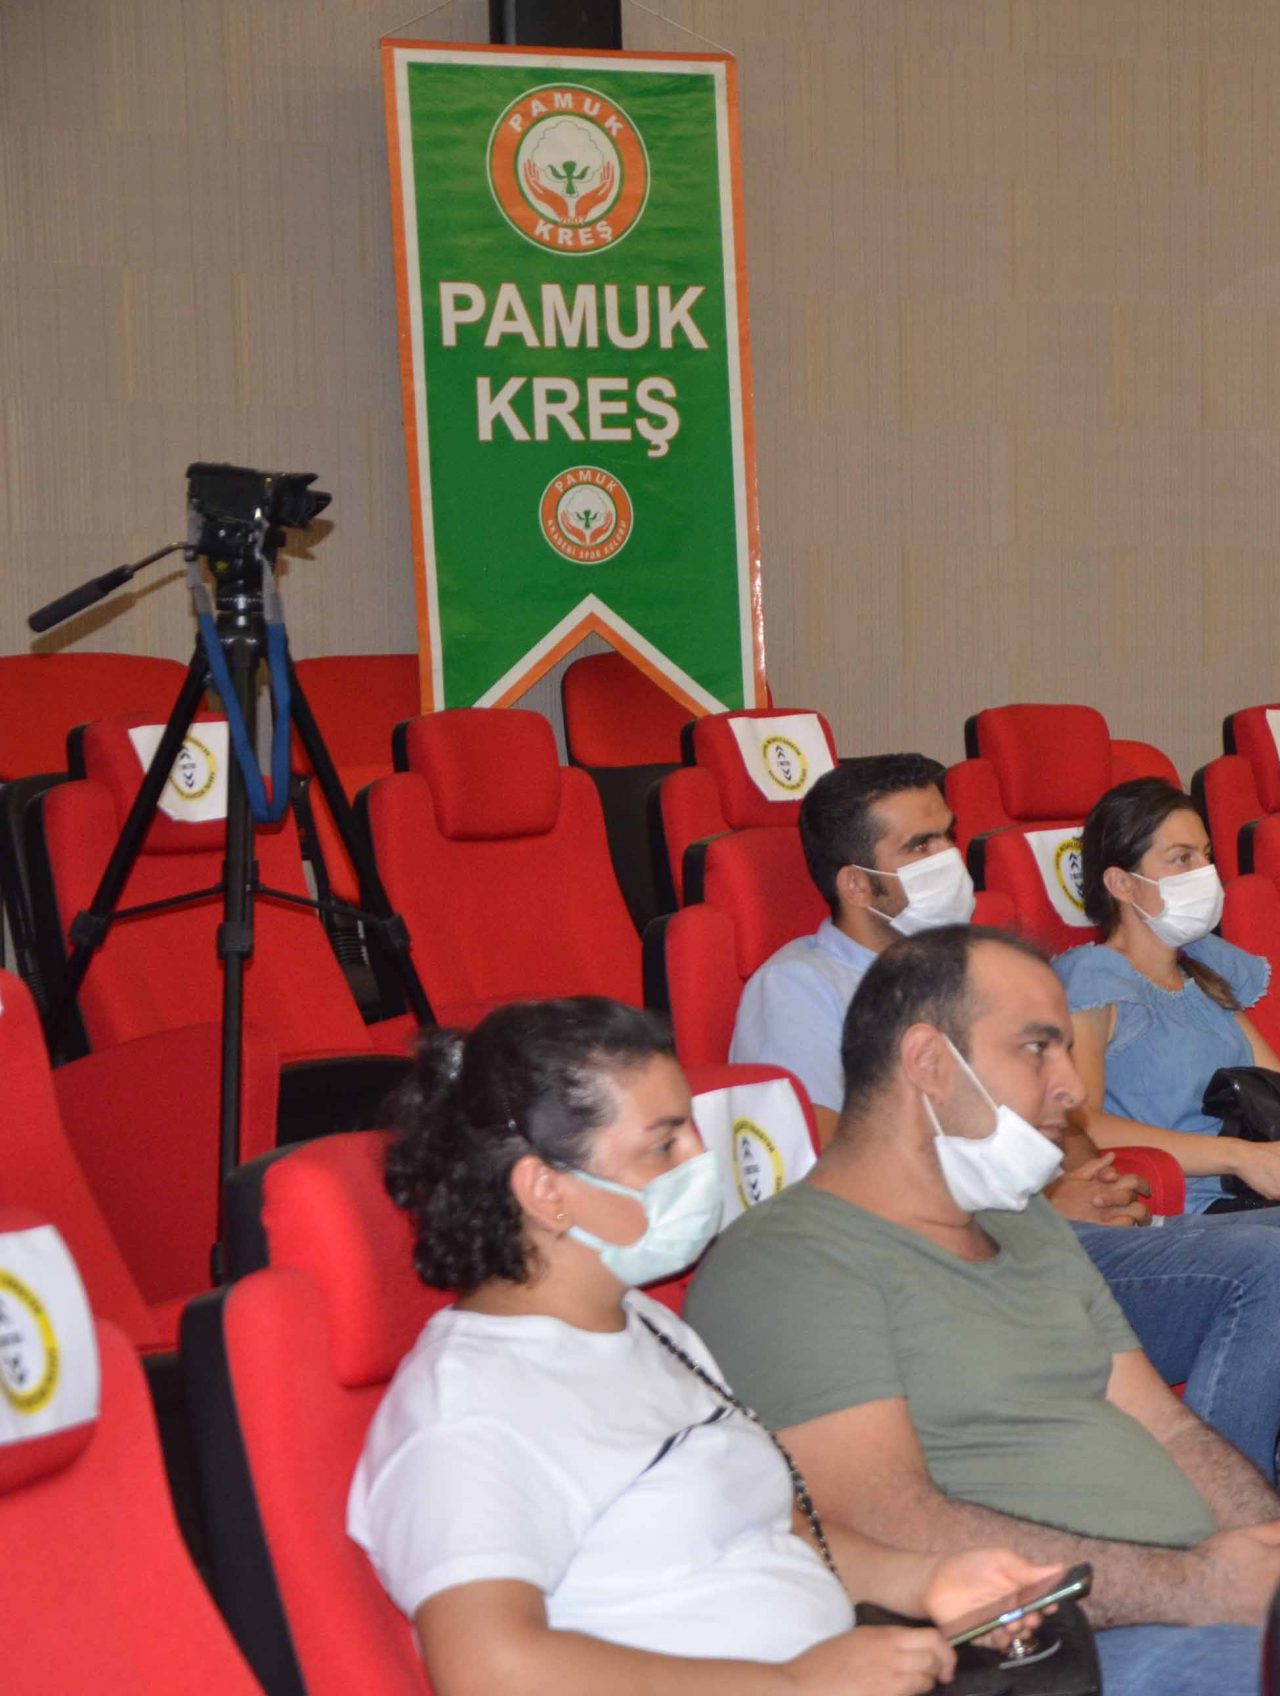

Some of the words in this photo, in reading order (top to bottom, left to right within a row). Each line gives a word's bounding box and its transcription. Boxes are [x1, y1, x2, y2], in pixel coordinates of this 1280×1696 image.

[508, 92, 624, 137] PAMUK
[533, 218, 613, 247] KREŞ
[438, 281, 710, 350] PAMUK
[475, 375, 681, 459] KREŞ
[554, 469, 618, 494] PAMUK
